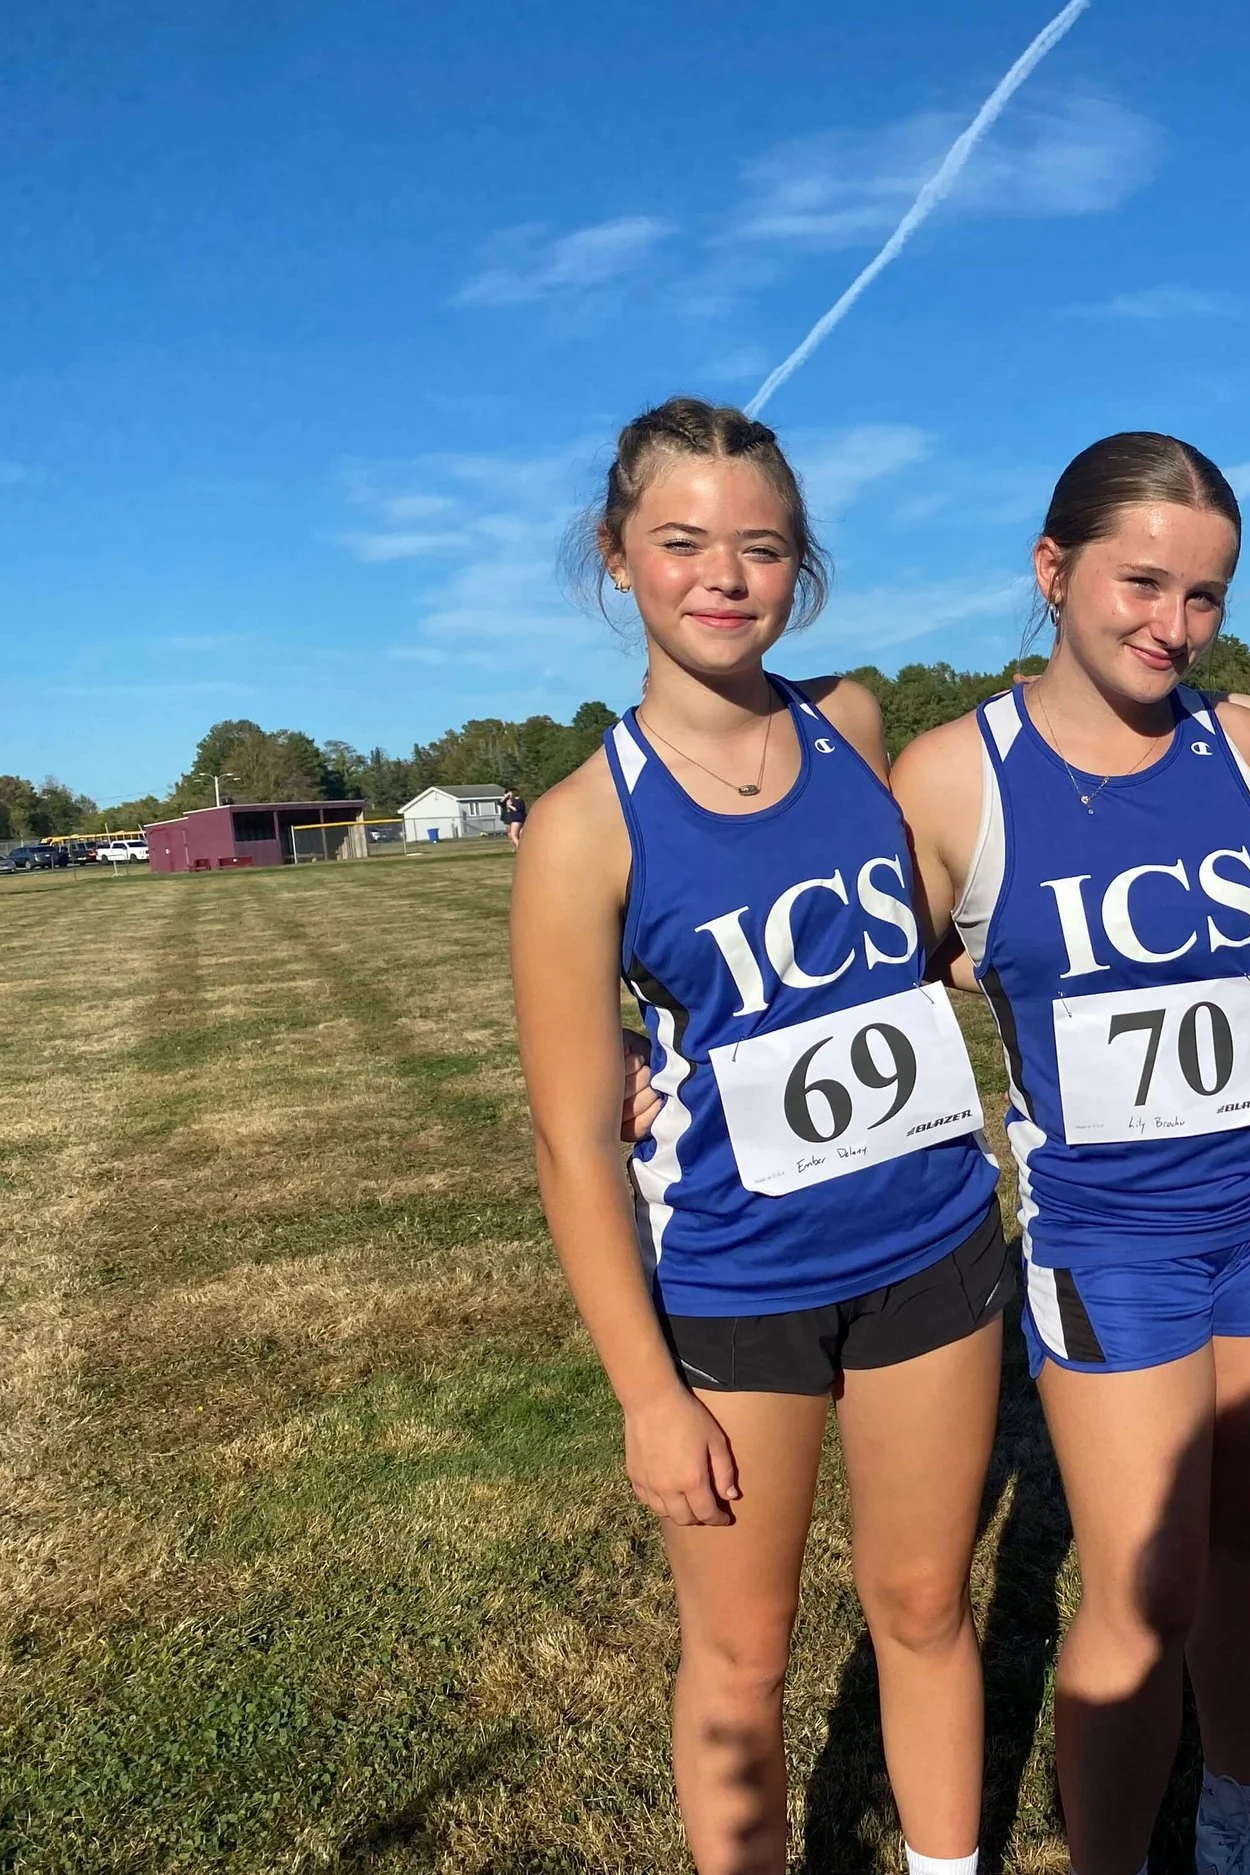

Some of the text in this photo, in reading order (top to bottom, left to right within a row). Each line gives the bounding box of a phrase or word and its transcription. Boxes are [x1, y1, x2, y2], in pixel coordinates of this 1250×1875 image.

[695, 854, 919, 1017] ICS
[784, 1022, 917, 1143] 69
[1108, 1001, 1234, 1106] 70
[915, 1109, 973, 1134] BLAZER
[1128, 1116, 1145, 1134] Lily
[796, 1155, 826, 1173] Ember
